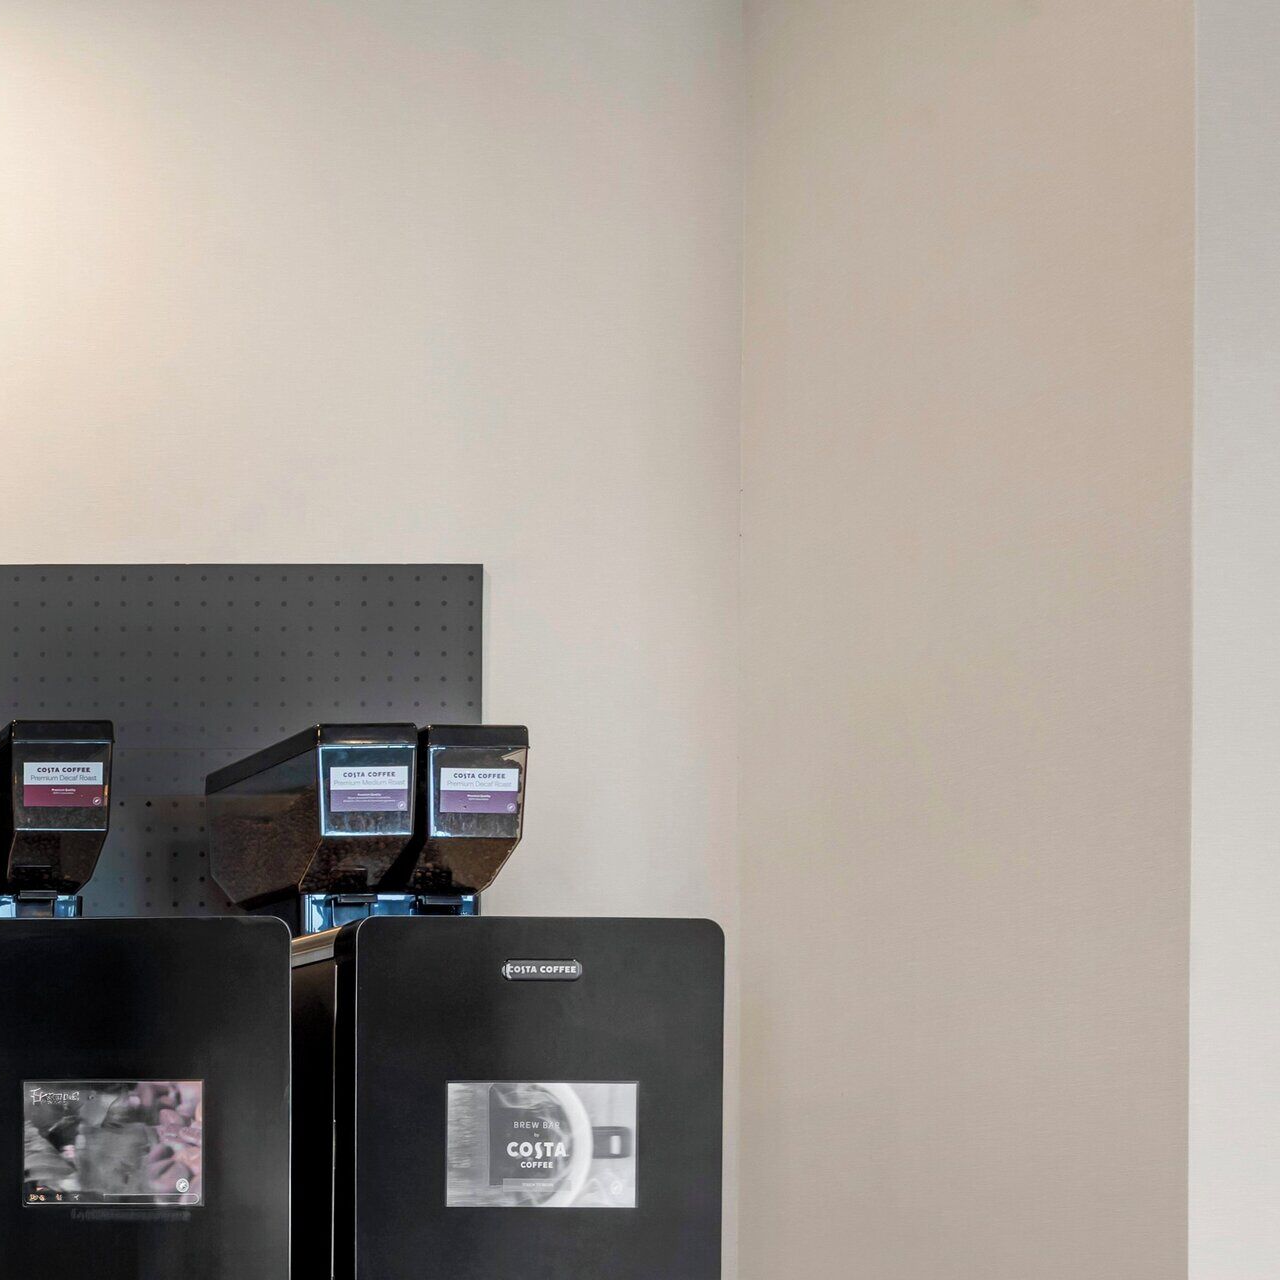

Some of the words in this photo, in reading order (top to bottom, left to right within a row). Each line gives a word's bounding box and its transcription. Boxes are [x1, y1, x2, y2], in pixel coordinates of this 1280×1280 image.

[540, 965, 576, 973] COFFEE
[513, 1121, 540, 1129] BREW
[542, 1121, 560, 1129] BAR
[506, 1141, 567, 1159] COSTA
[520, 1161, 553, 1169] COFFEE
